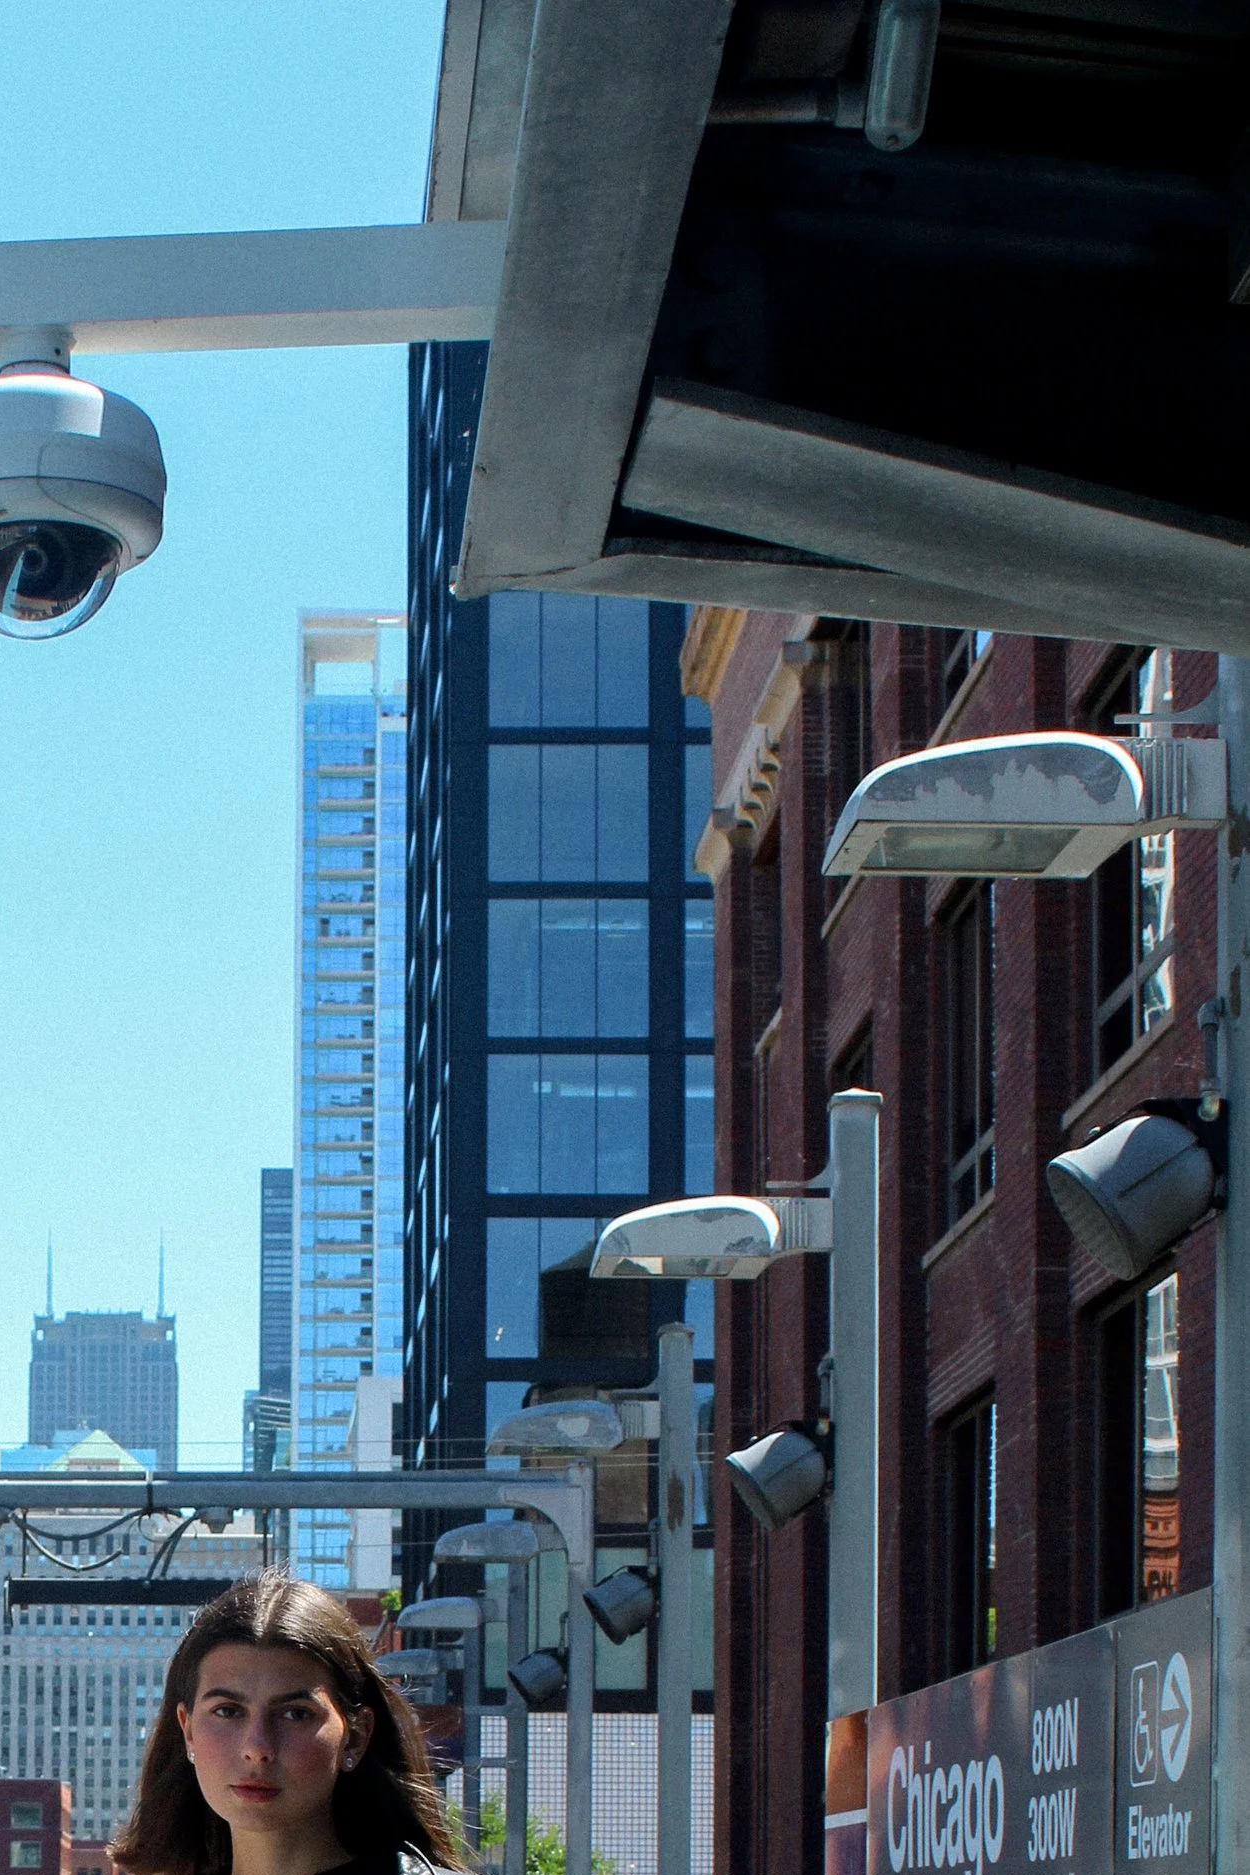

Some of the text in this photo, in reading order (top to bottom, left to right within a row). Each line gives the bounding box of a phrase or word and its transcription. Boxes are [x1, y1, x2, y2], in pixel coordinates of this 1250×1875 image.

[1031, 1697, 1079, 1776] 800N
[1027, 1787, 1077, 1862] 300W
[1127, 1803, 1193, 1860] Elevator
